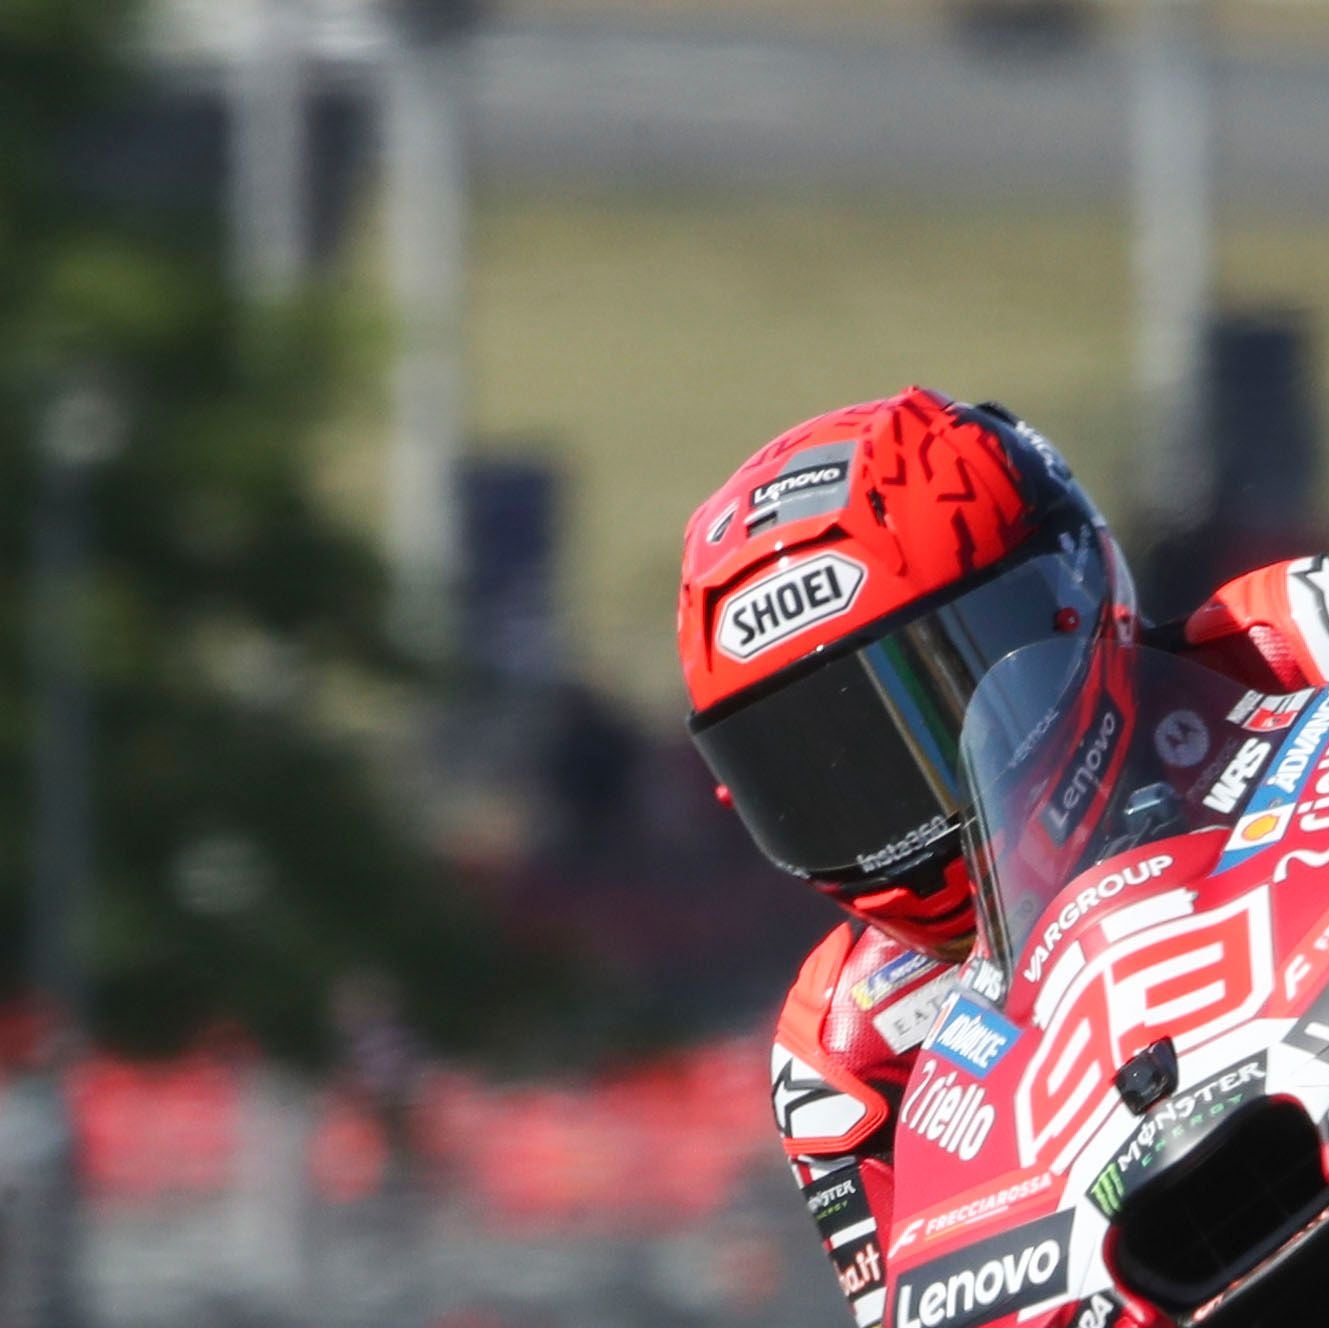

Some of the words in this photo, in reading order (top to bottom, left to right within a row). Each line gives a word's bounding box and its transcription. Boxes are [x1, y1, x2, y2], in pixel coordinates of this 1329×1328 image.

[753, 467, 841, 504] Lenovo
[731, 565, 844, 646] SHOEI
[1048, 711, 1117, 829] Lenovo
[1202, 737, 1272, 814] WRS
[1022, 854, 1174, 984] VARGROUP
[936, 1012, 1008, 1069] ADVANCE
[911, 1074, 996, 1161] riello
[925, 1171, 1053, 1232] FRECCIAROSSA
